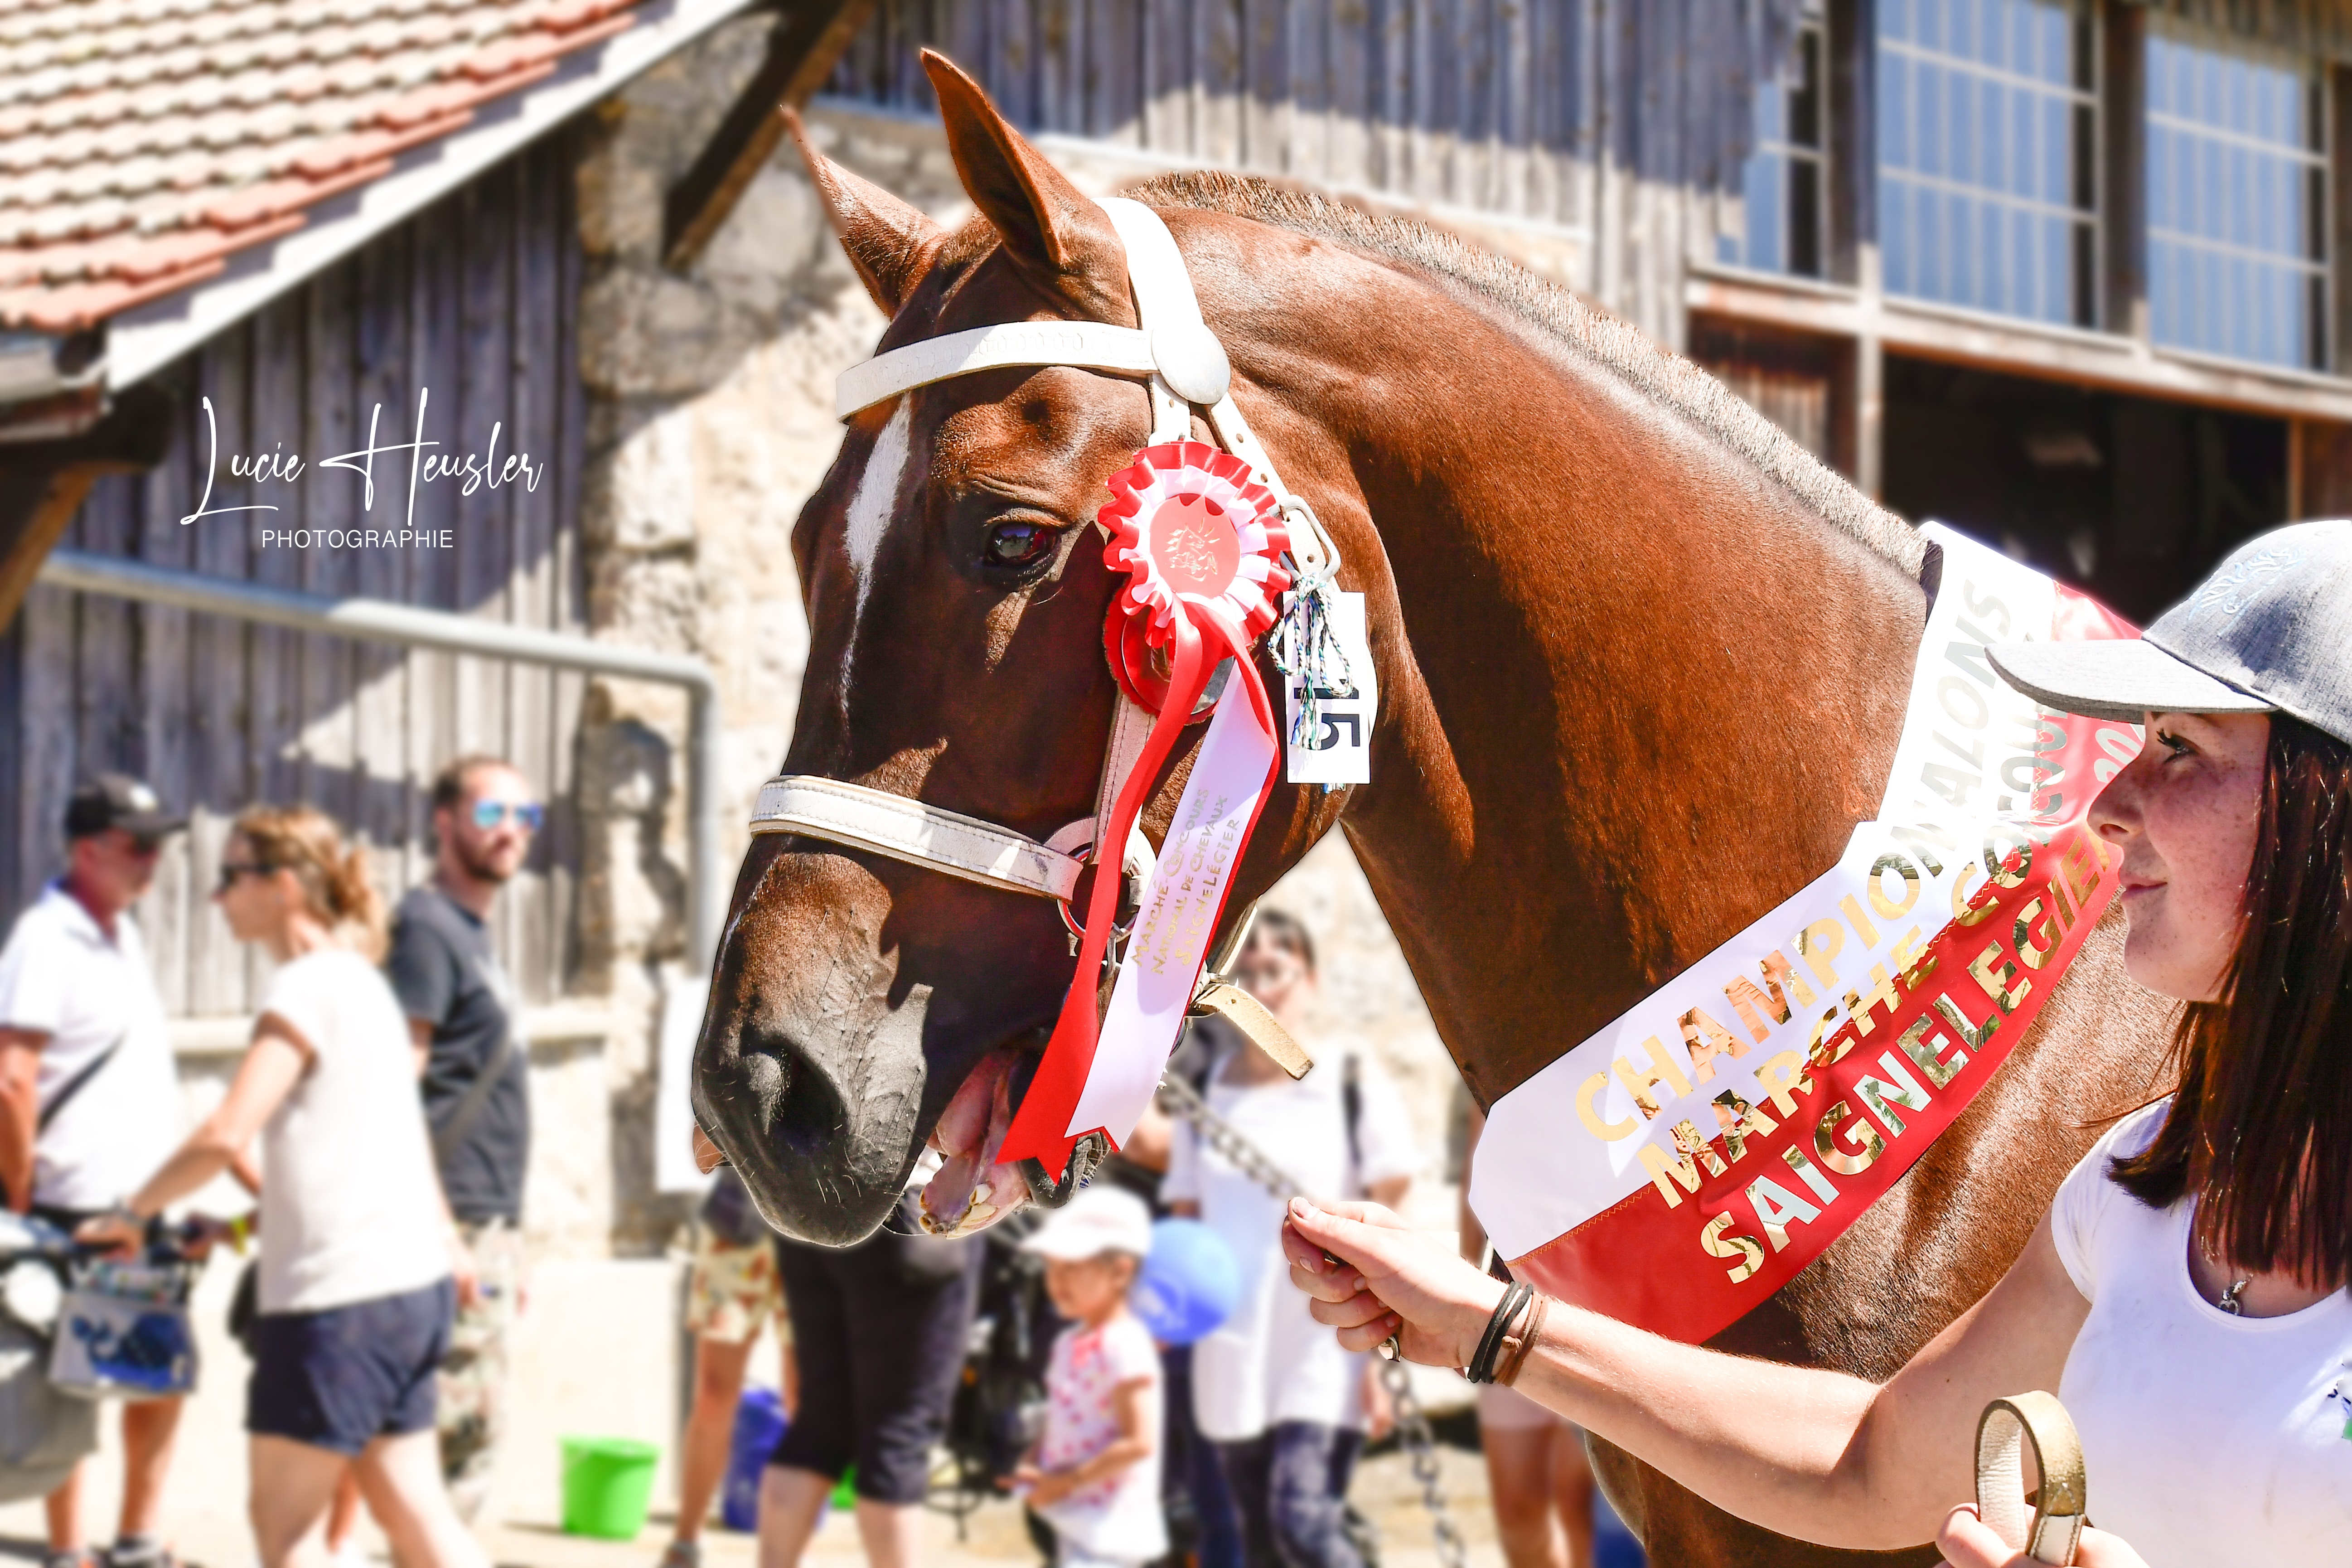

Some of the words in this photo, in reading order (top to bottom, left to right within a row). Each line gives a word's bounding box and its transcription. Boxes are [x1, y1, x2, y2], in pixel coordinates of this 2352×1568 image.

[1293, 678, 1360, 750] 15
[1151, 896, 1187, 975] NATIONAL
[1181, 874, 1194, 892] DE
[1190, 794, 1228, 872] CHEVAUX
[1175, 818, 1239, 966] SAIGNELÉGIER
[1636, 925, 1938, 1209] MARCHE
